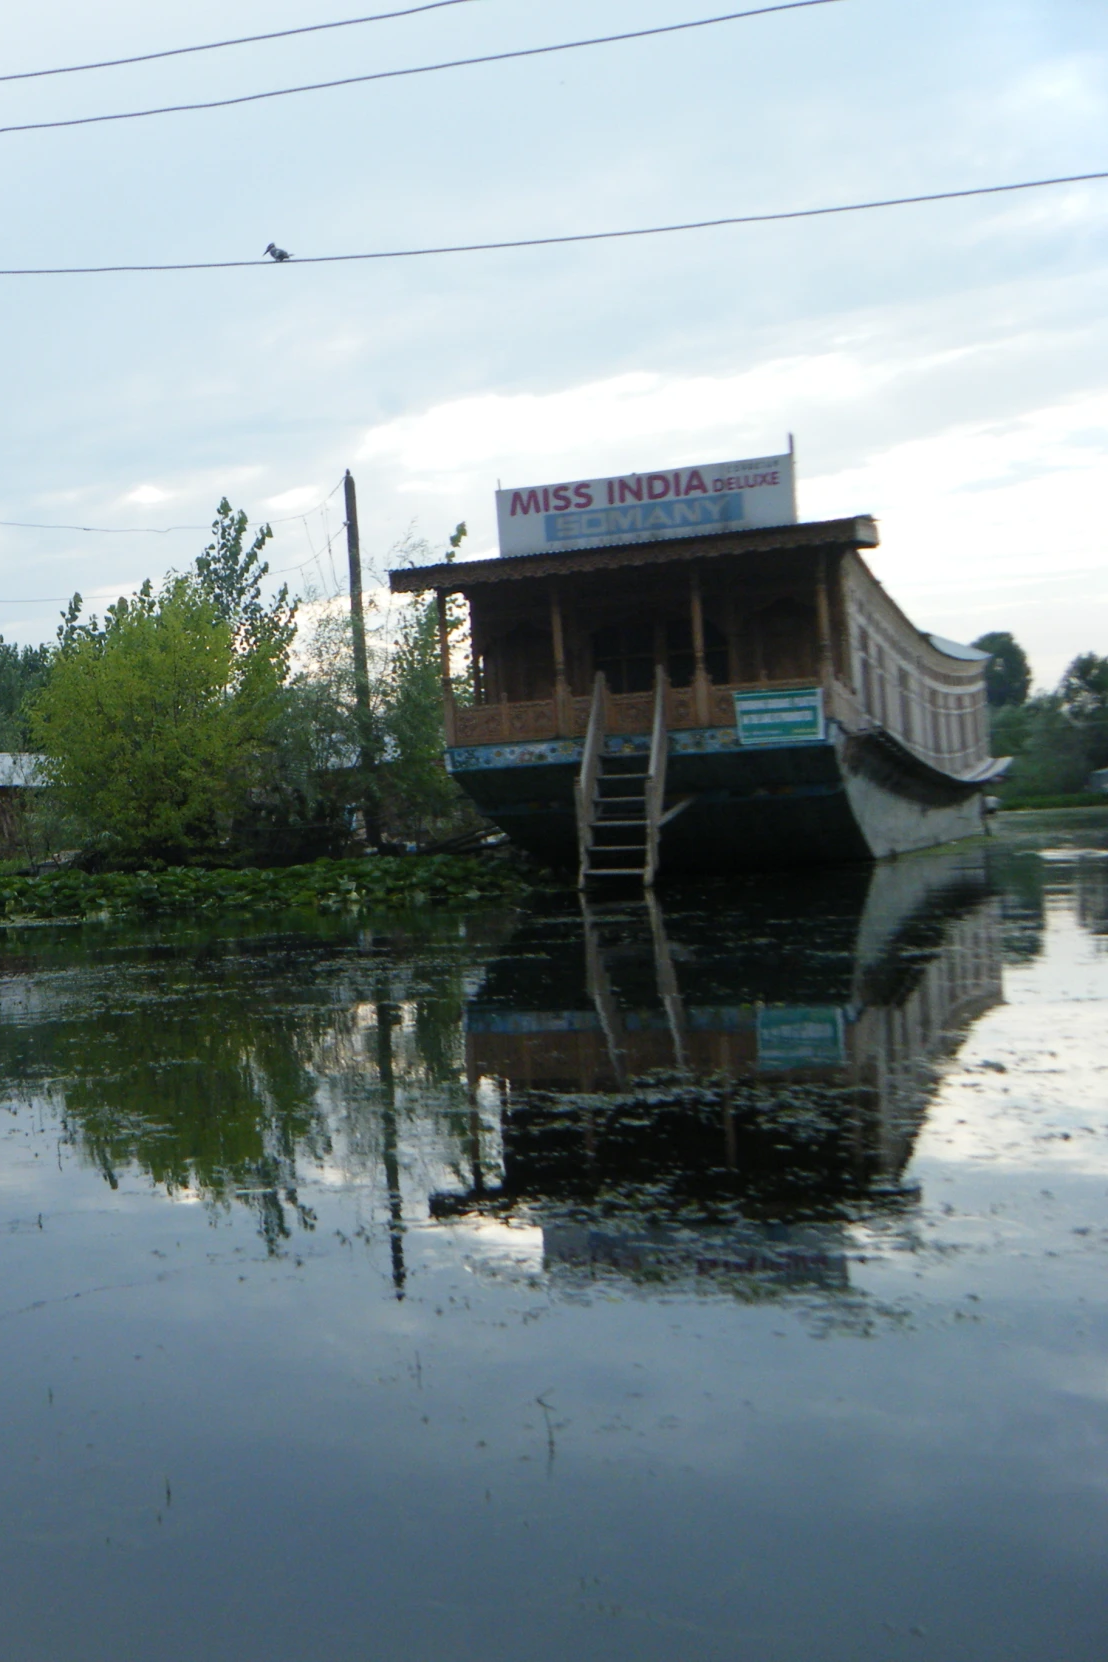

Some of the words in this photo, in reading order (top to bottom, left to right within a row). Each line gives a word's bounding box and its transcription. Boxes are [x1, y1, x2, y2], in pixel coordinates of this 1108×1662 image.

[510, 482, 593, 516] MISS
[608, 470, 707, 504] INDIA
[713, 471, 781, 492] DELUXE
[556, 496, 731, 537] SOMANY
